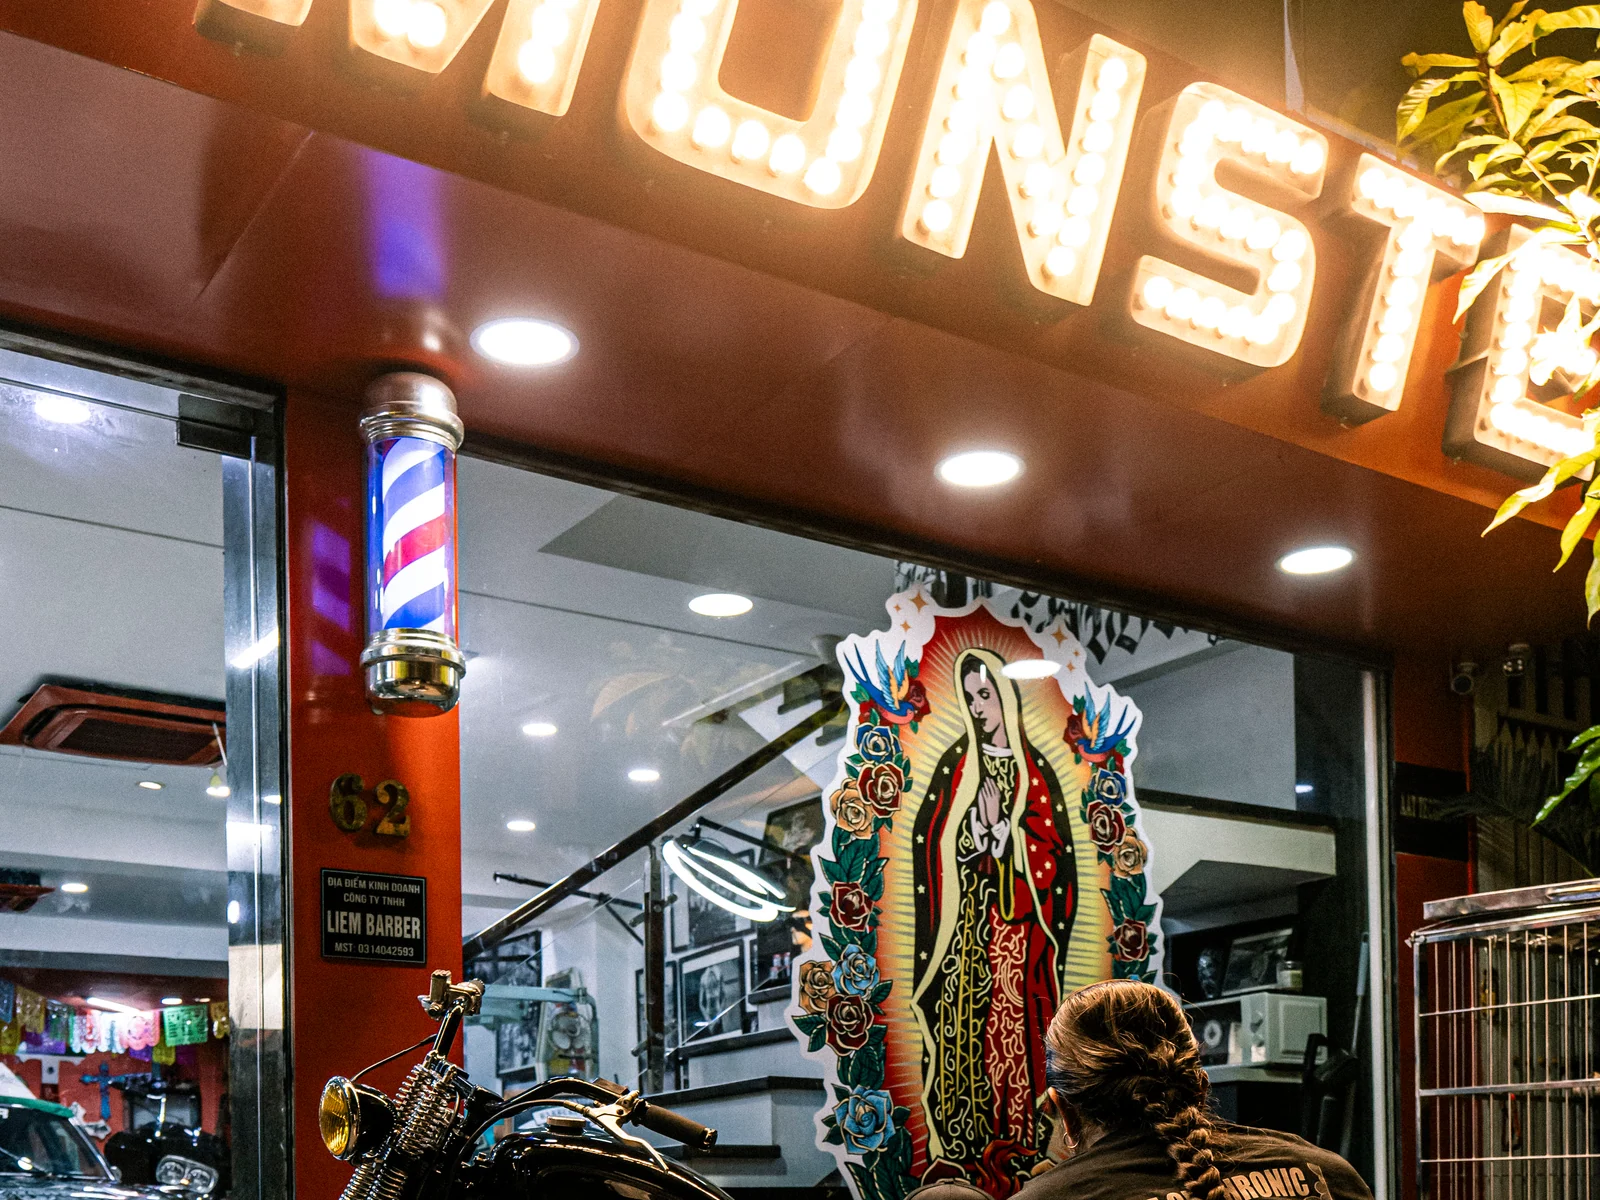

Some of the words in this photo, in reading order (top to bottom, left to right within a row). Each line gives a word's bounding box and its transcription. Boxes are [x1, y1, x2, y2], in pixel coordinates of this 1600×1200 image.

[192, 0, 1600, 481] ONSTE
[330, 772, 411, 837] 62
[368, 880, 390, 891] KINH
[391, 882, 421, 894] DOANH
[343, 892, 367, 904] CÔNG
[369, 895, 380, 905] TY
[382, 896, 406, 907] TNHH
[326, 910, 362, 935] LIEM
[365, 913, 421, 939] BARBER
[334, 942, 355, 953] MST:
[357, 943, 415, 957] 0314042593
